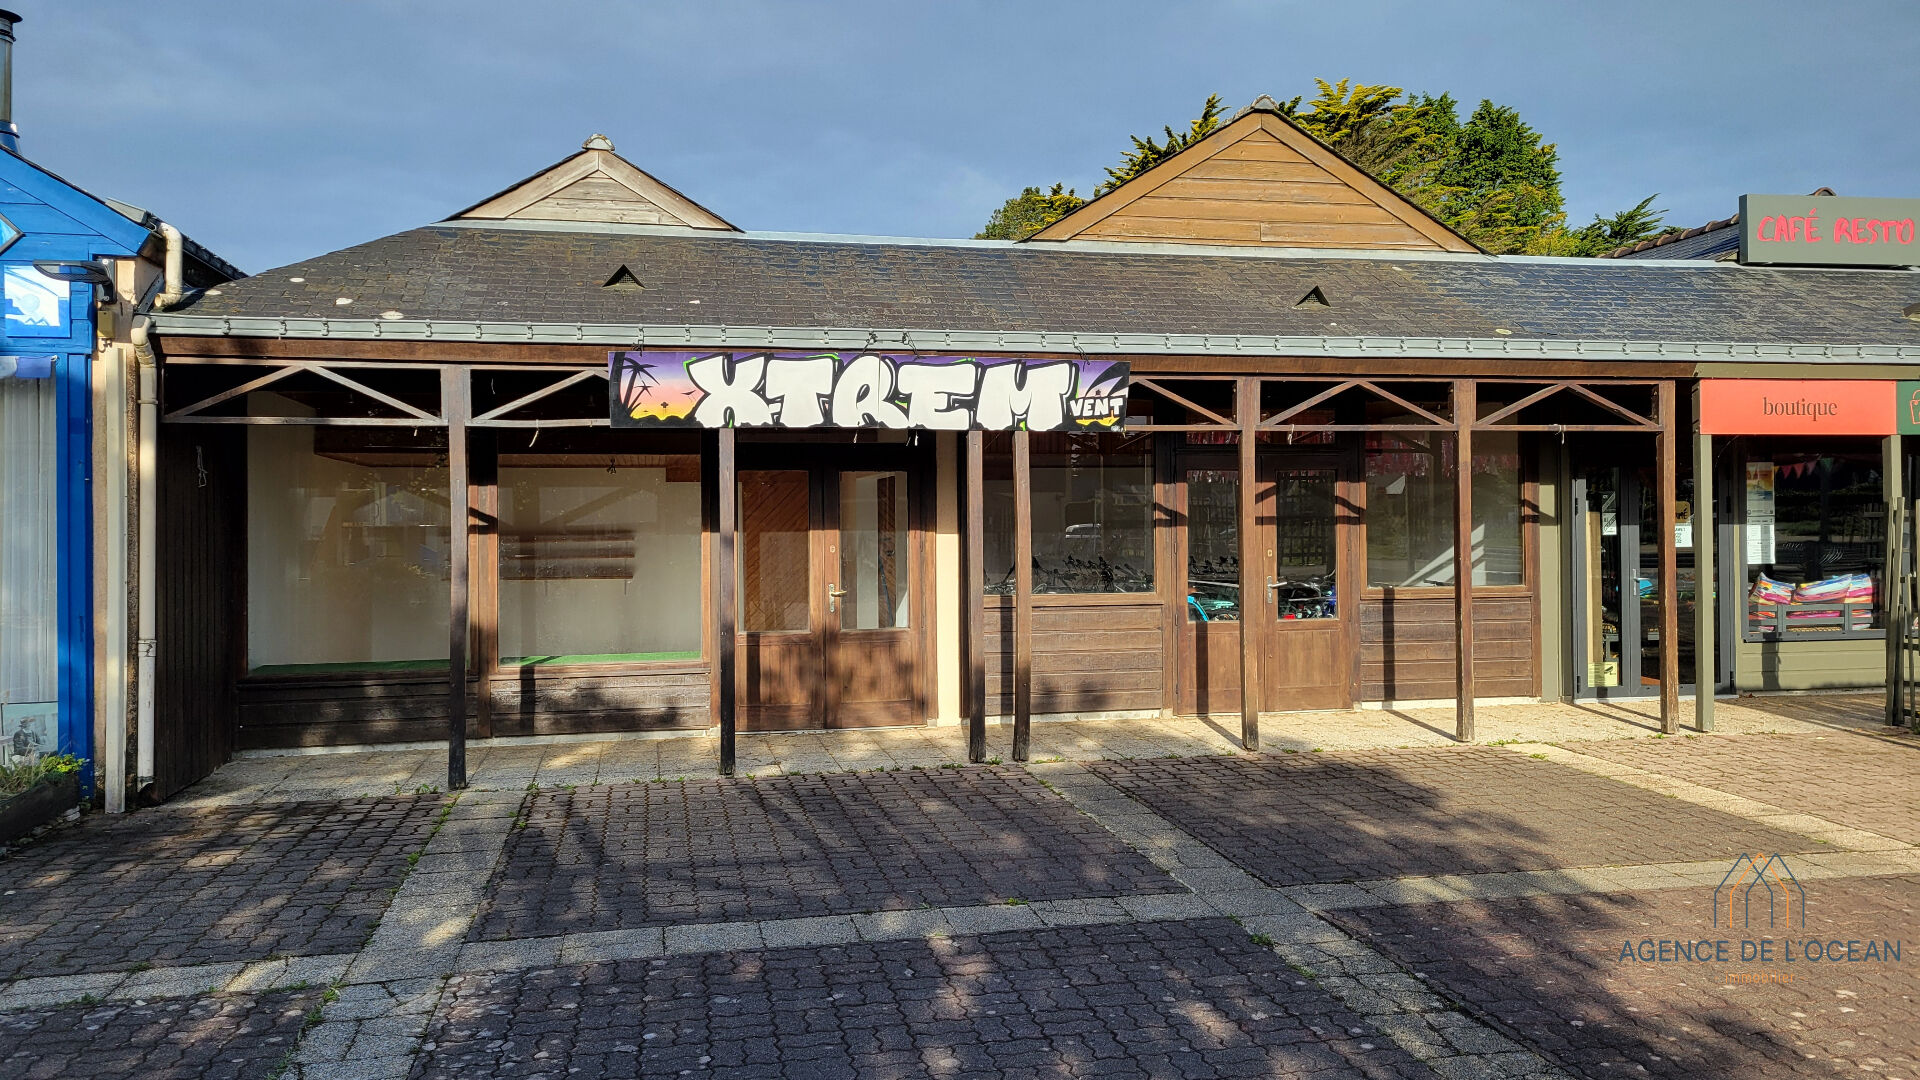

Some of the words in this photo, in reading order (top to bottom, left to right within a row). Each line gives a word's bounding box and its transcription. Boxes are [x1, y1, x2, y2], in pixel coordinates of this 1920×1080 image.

[1757, 208, 1822, 242] CAFÉ
[1833, 218, 1915, 245] RESTO
[689, 353, 1074, 431] XTREM
[1069, 397, 1124, 417] VENT
[1763, 397, 1838, 421] boutique
